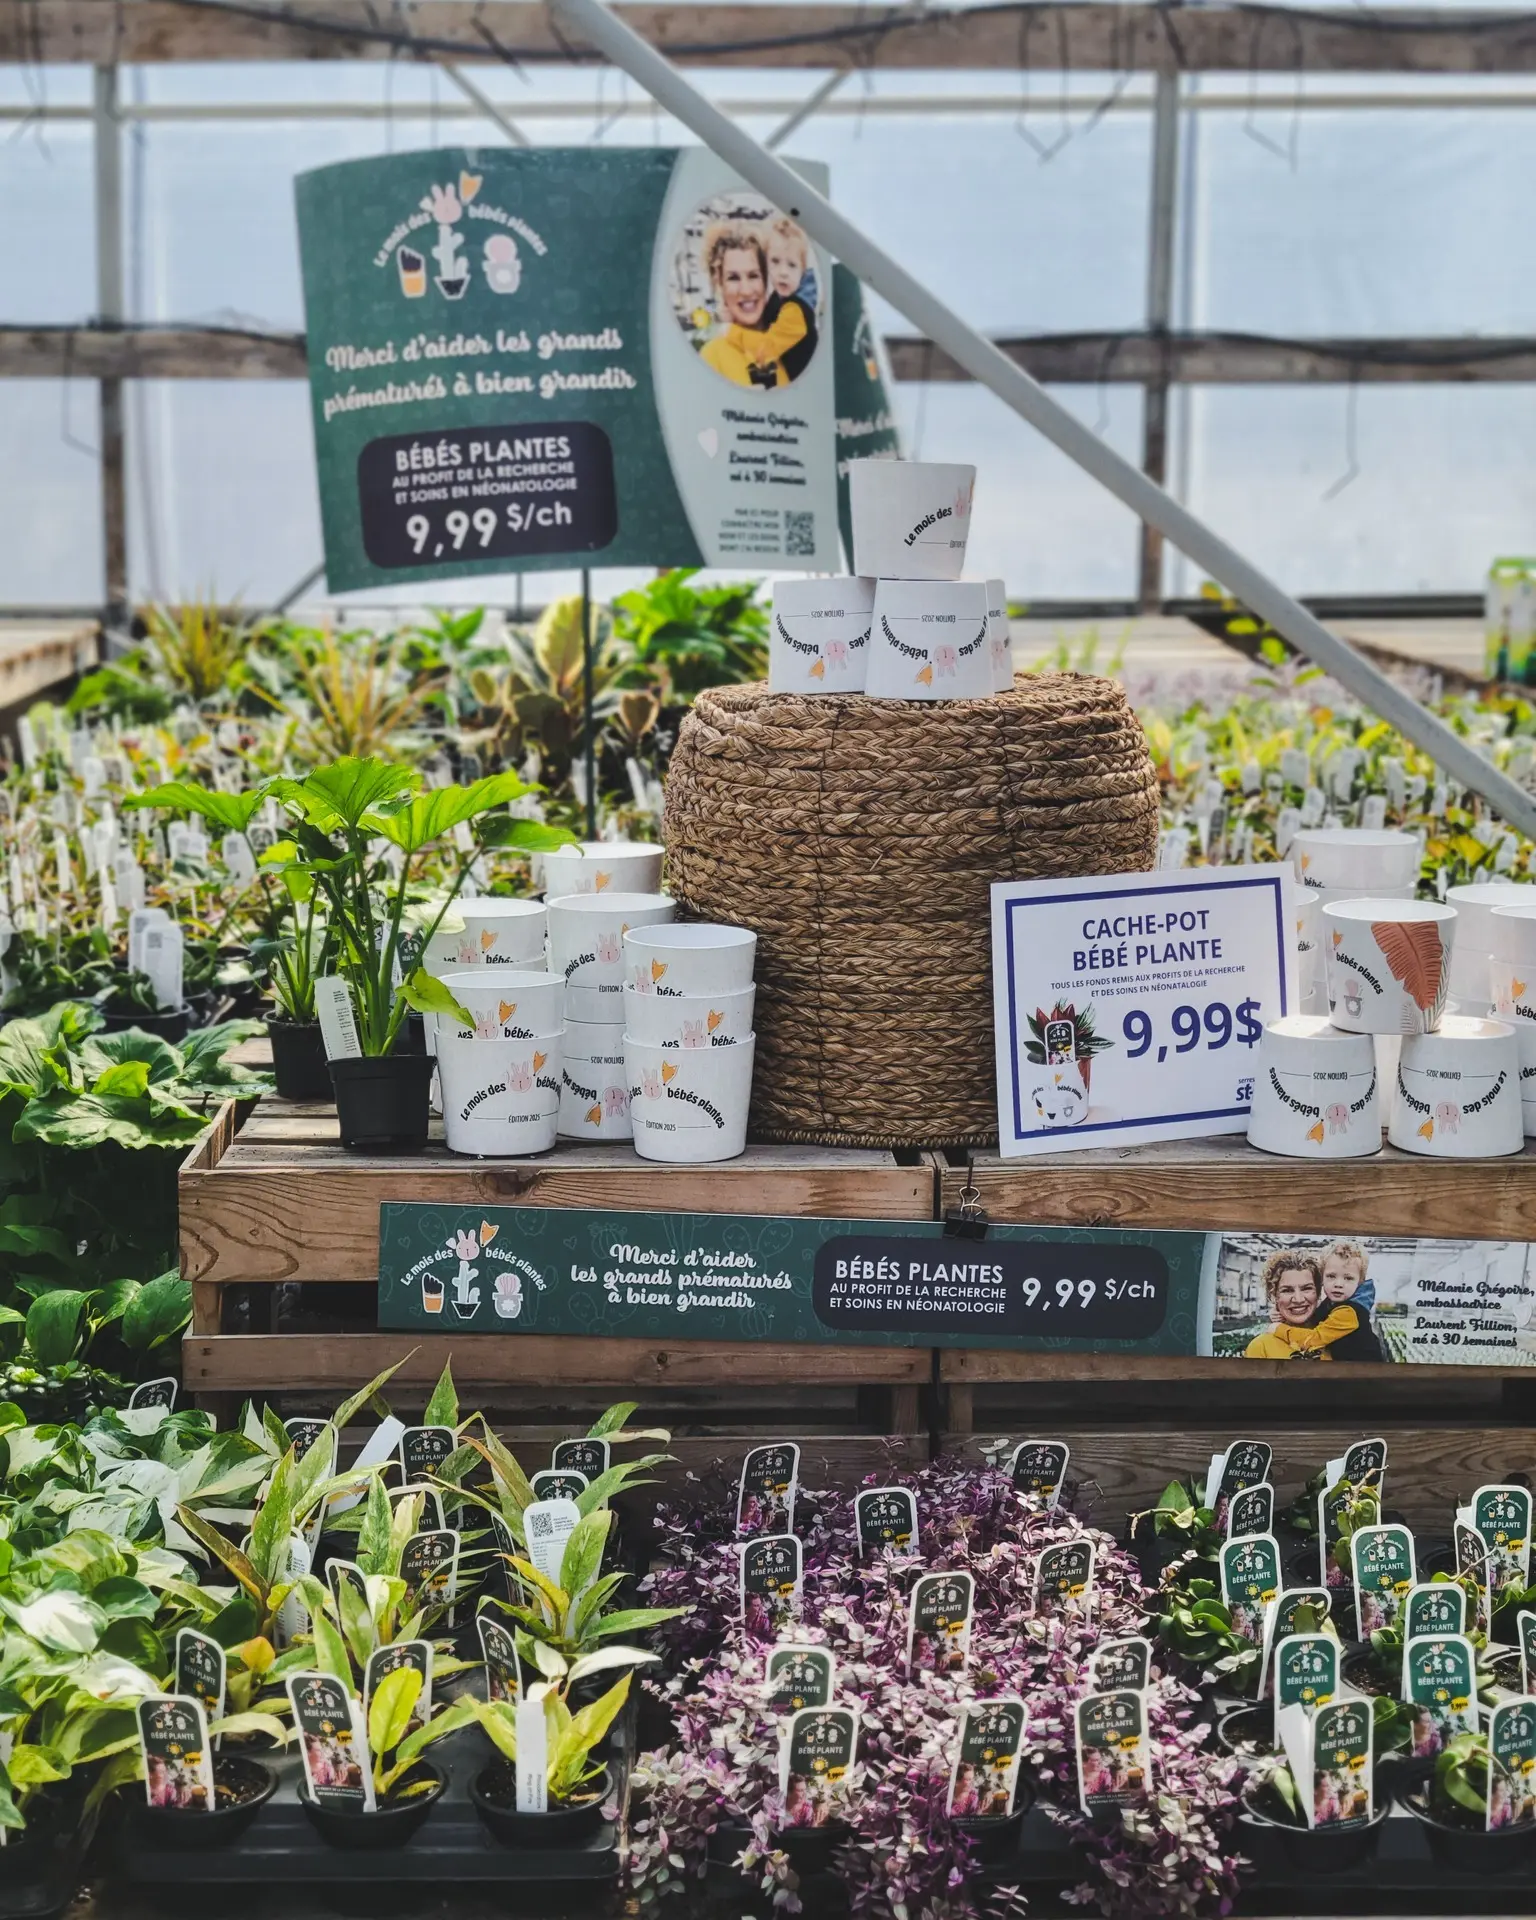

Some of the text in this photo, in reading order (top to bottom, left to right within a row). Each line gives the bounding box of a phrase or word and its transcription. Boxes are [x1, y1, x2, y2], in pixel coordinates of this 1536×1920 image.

[468, 203, 508, 225] bébés
[507, 216, 549, 256] plantes
[325, 327, 623, 373] Merci d'aider les grands
[323, 367, 637, 421] prématurés à bien grandir
[395, 436, 572, 472] BÉBÉS PLANTES
[392, 461, 576, 489] AU PROFIT DE LA RECHERCHE
[395, 477, 578, 505] ET SOINS EN NÉONATOLOGIE
[406, 501, 574, 557] 9,99 $/ch
[904, 507, 953, 547] Le mois des
[880, 615, 900, 648] plantes
[793, 636, 865, 655] des bébés
[899, 643, 929, 660] bébés
[959, 643, 974, 657] des
[1082, 909, 1210, 940] CACHE-POT
[1073, 938, 1223, 971] BÉBÉ PLANTE
[564, 952, 596, 979] mois des
[1336, 952, 1384, 995] bébés plantes
[1051, 965, 1246, 990] TOUS LES FONDS REMIS AUX PROFITS DE LA RECHERCHE
[598, 984, 620, 993] ÉDITION
[1101, 988, 1115, 996] DES
[1116, 986, 1138, 995] SOINS
[1139, 985, 1150, 993] EN
[1151, 979, 1208, 992] NÉONATALOGIE
[1122, 997, 1263, 1063] 9,99$
[591, 1056, 625, 1065] ÉDITION 2025
[1313, 1071, 1348, 1081] ÉDITION 2025
[1426, 1068, 1462, 1081] ÉDITION 2025
[460, 1108, 471, 1122] Le
[467, 1089, 488, 1111] mois
[487, 1083, 507, 1096] des
[536, 1076, 557, 1092] bébés
[570, 1081, 597, 1101] bébés
[1269, 1066, 1365, 1118] des bébés plantes
[1405, 1070, 1507, 1115] Le mois des bébés
[668, 1087, 725, 1129] bébés plantes
[508, 1113, 541, 1123] ÉDITION 2025
[645, 1119, 677, 1132] ÉDITION 2025
[609, 1243, 757, 1268] Merci d'aider
[400, 1247, 548, 1291] Le mois des bébés plantes
[570, 1264, 793, 1291] les grands prématurés
[835, 1255, 1004, 1284] BÉBÉS PLANTES
[830, 1283, 1007, 1299] AU PROFIT DE LA RECHERCHE
[1022, 1277, 1156, 1312] 9,99 $/ch
[1417, 1279, 1535, 1298] Mélanie Grégoire,
[607, 1287, 756, 1312] à bien grandir
[830, 1298, 1006, 1314] ET SOINS EN NÉONATOLOGIE
[1416, 1297, 1502, 1310] ambassadrice
[1414, 1316, 1518, 1334] Laurent Fillion,
[1412, 1332, 1518, 1347] né à 30 semaines
[1481, 1521, 1497, 1529] BÉBÉ
[1232, 1571, 1271, 1584] BÉBÉ PLANTE
[1364, 1563, 1405, 1573] BÉBÉ PLANTE
[1415, 1622, 1455, 1633] BÉBÉ PLANTE
[1286, 1675, 1329, 1685] BÉBÉ PLANTE
[1418, 1676, 1464, 1686] BÉBÉ PLANTE
[304, 1709, 345, 1719] BÉBÉ PLANTE
[1087, 1719, 1134, 1731] BÉBÉ PLANTE
[151, 1731, 195, 1741] BÉBÉ PLANTE
[969, 1735, 1013, 1744] BÉBÉ PLANTE
[1320, 1735, 1362, 1750] BÉBÉ PLANTE
[798, 1745, 844, 1755] BÉBÉ PLANTE
